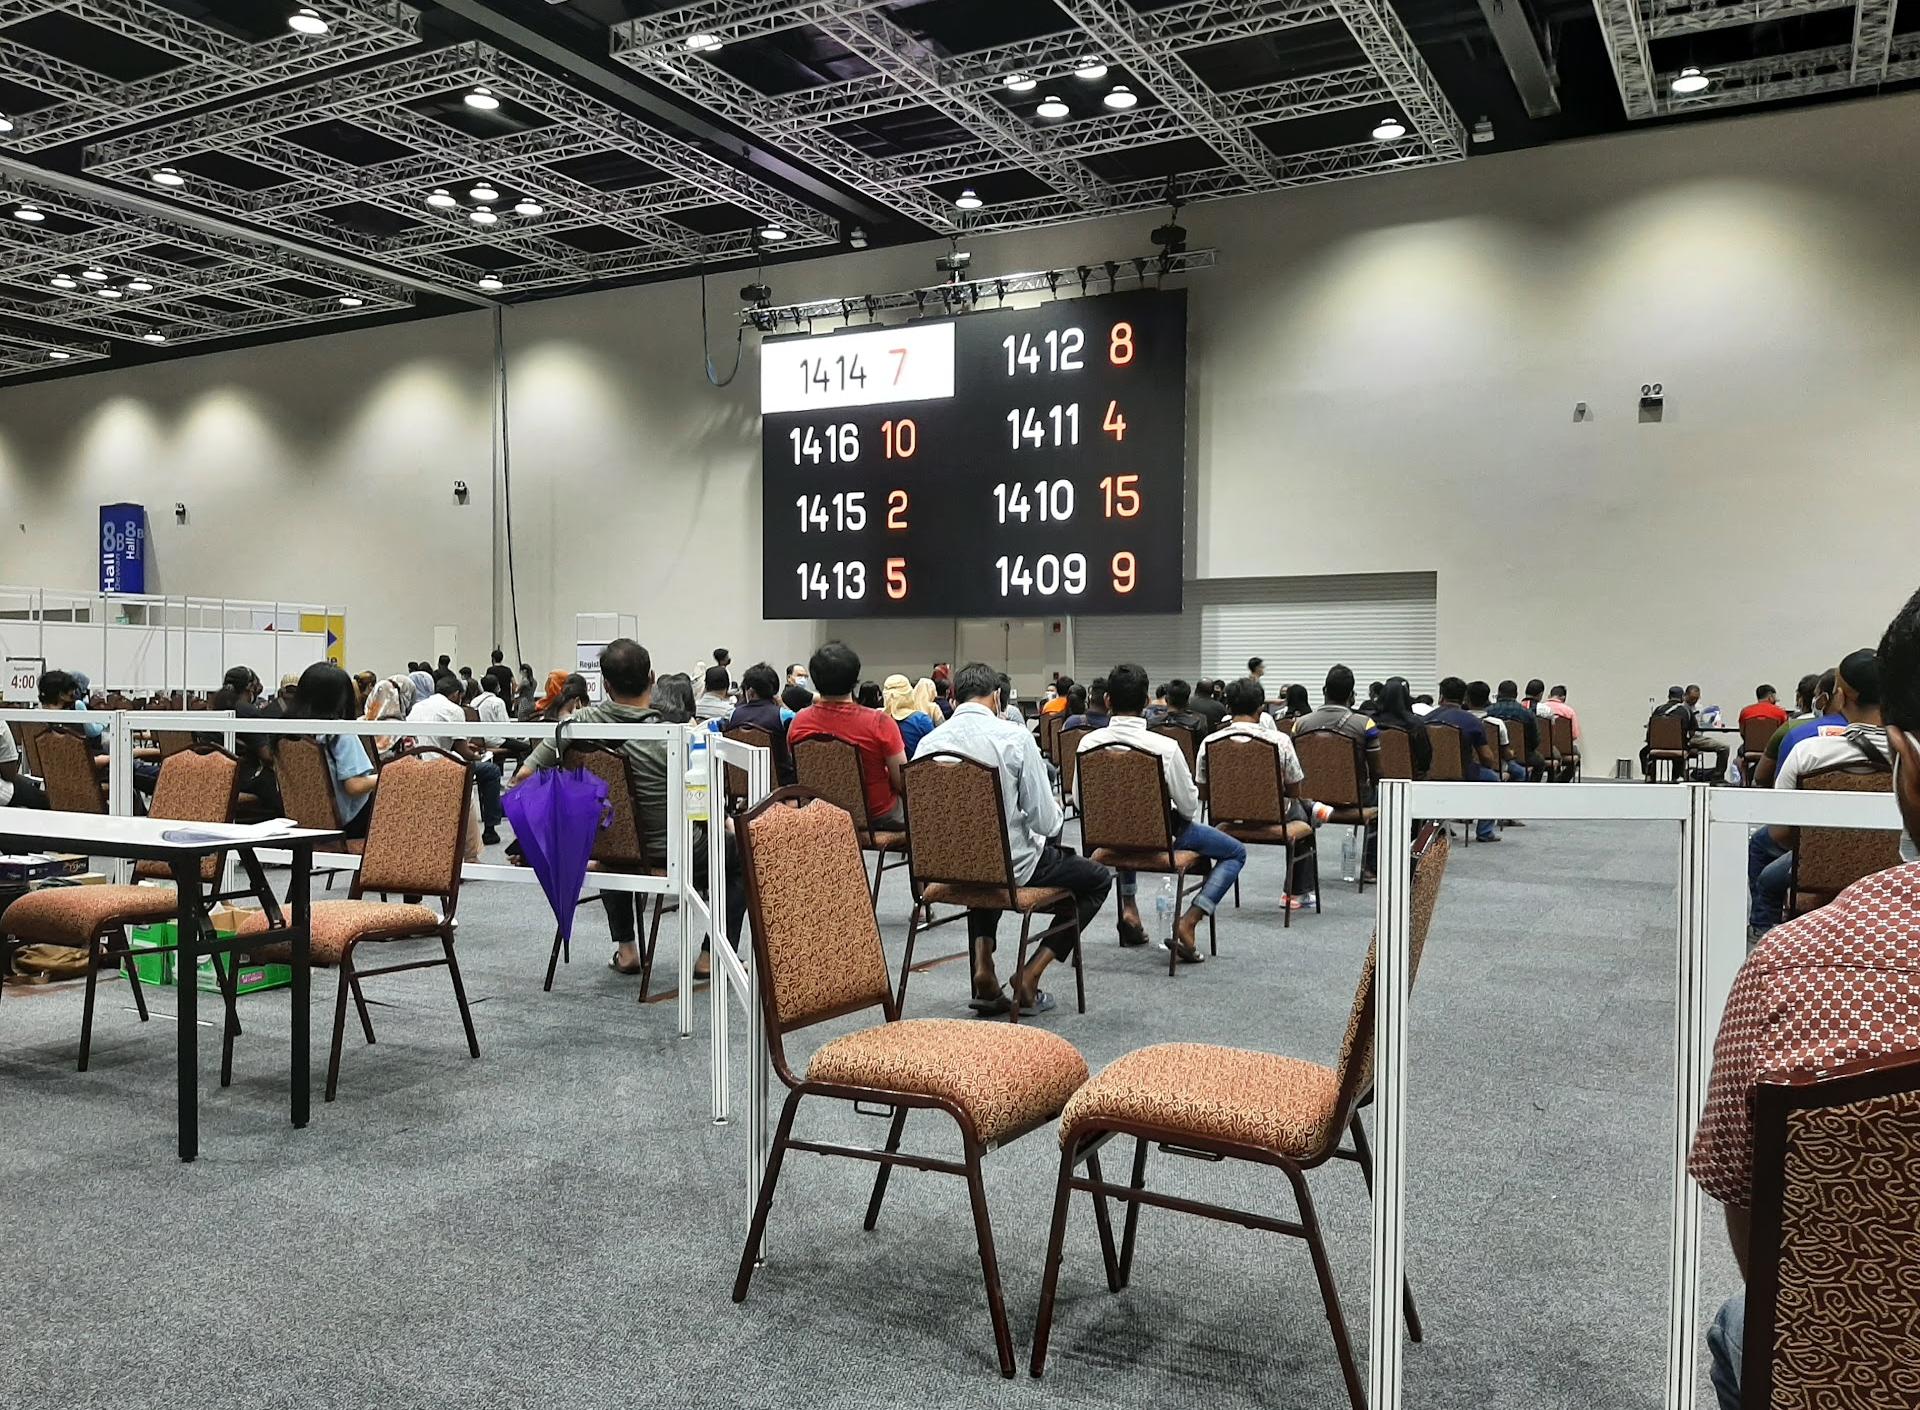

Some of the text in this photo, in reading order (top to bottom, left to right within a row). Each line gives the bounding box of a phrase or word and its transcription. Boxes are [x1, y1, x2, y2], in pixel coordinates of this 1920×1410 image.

[800, 347, 908, 394] 1414 7
[1002, 322, 1134, 376] 1412 8
[789, 418, 916, 466] 1416 10
[1006, 400, 1127, 450] 1411 4
[796, 490, 908, 533] 1415 2
[993, 474, 1140, 524] 1410 15
[126, 537, 135, 560] Hall
[103, 553, 115, 592] Hall
[796, 557, 907, 600] 1413 5
[995, 551, 1136, 597] 1409 9
[11, 674, 35, 689] 4:00
[580, 661, 600, 669] Regist
